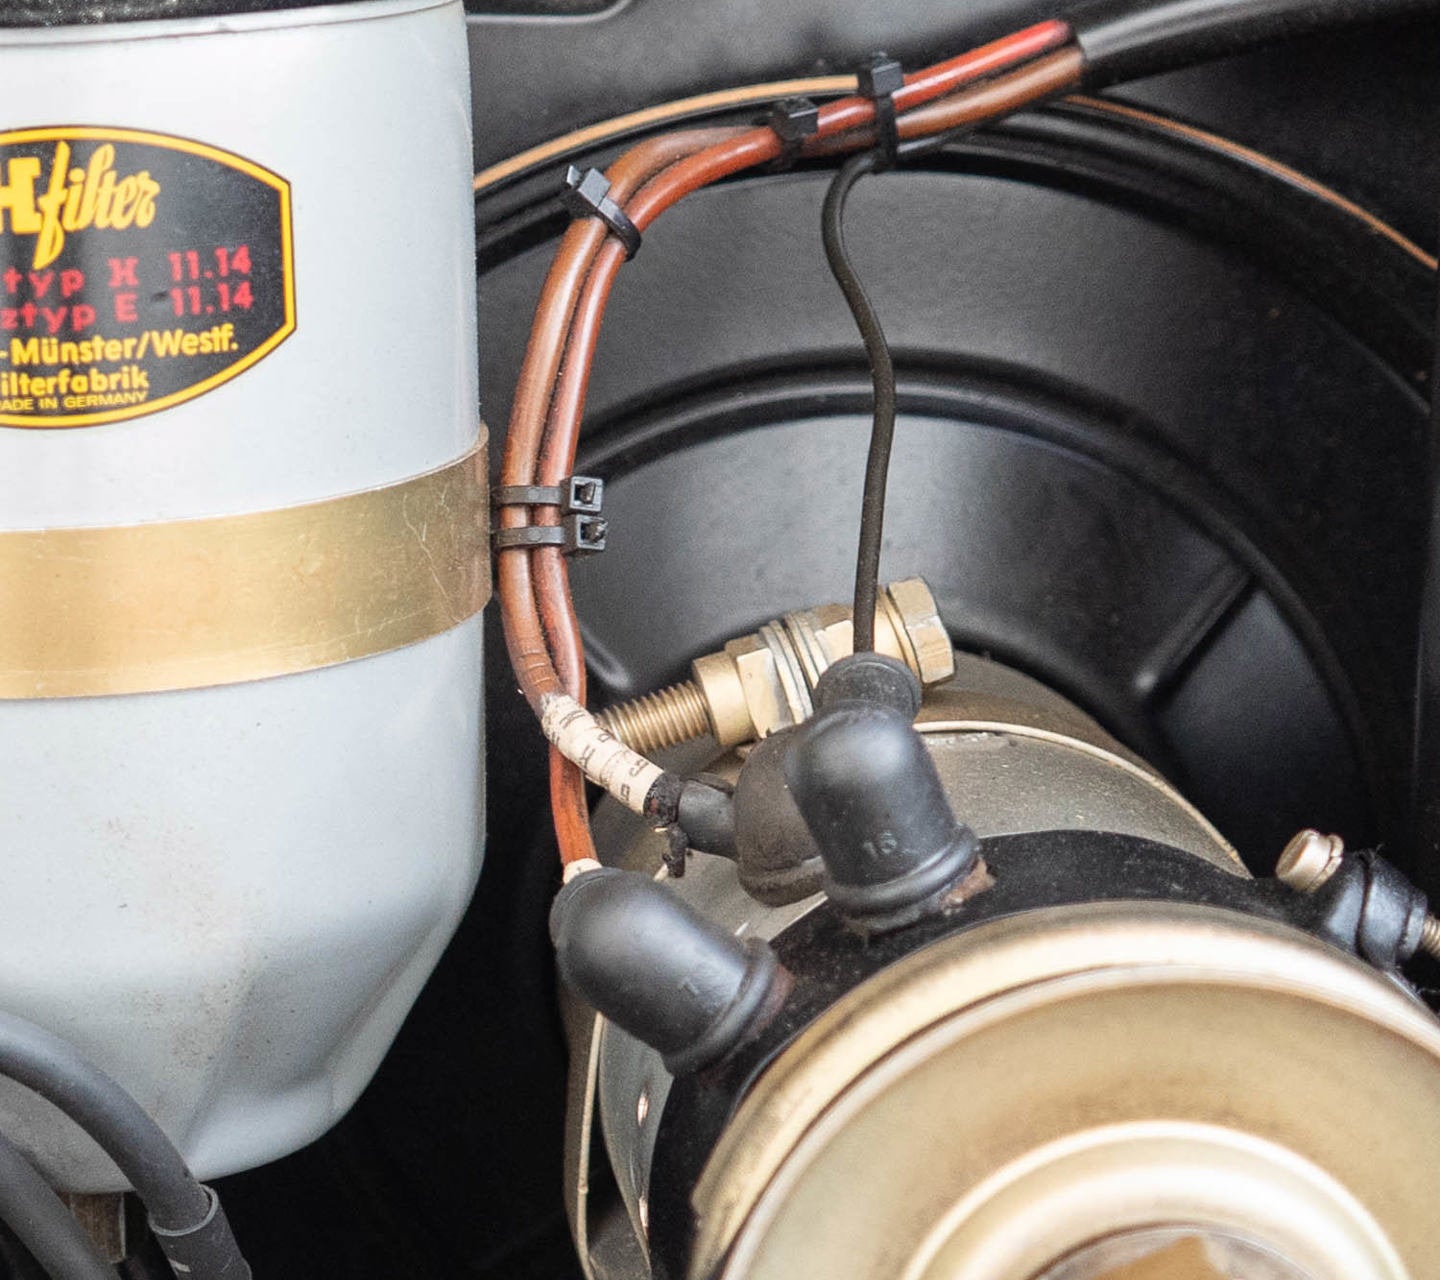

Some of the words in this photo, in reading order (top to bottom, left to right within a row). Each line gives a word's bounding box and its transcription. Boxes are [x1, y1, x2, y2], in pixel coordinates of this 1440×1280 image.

[169, 245, 253, 282] 11.14
[115, 292, 138, 323] E
[170, 281, 255, 317] 11.14
[38, 397, 58, 410] IN
[63, 390, 147, 410] GERMANY
